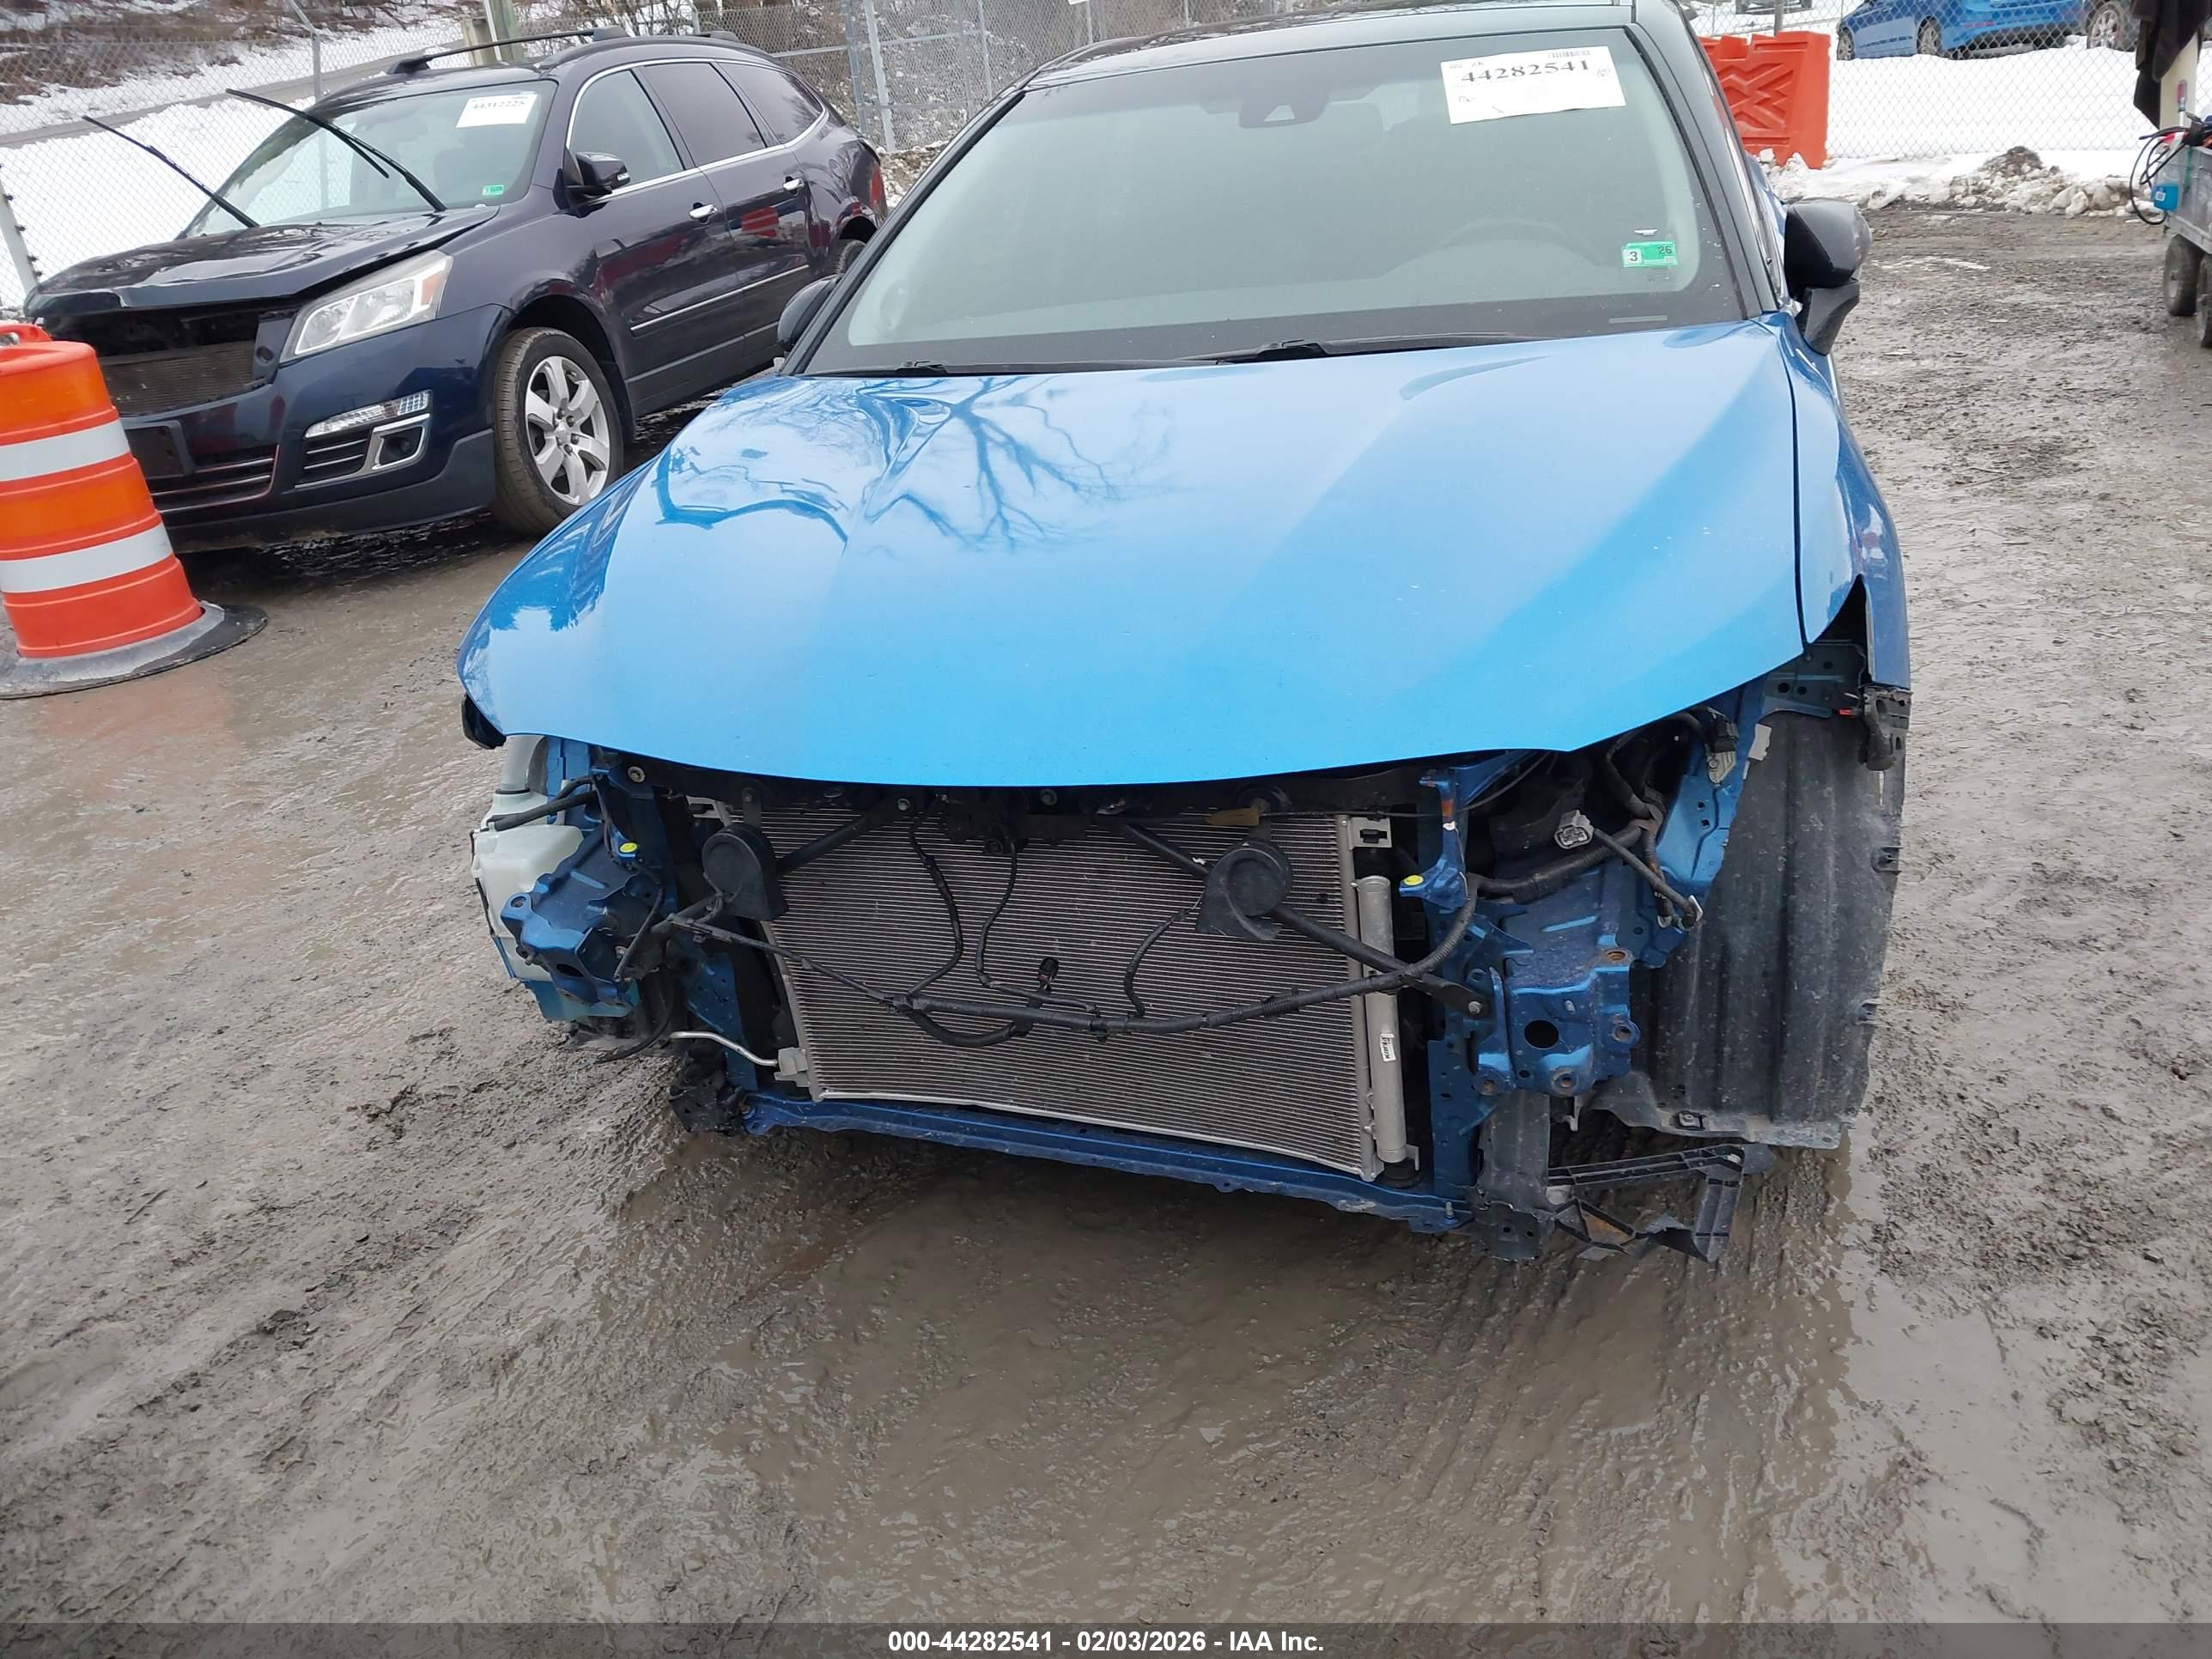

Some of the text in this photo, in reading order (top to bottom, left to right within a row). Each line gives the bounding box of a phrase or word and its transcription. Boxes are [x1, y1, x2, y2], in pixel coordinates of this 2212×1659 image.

[1461, 59, 1590, 83] 44282541
[1629, 246, 1673, 262] 3 26
